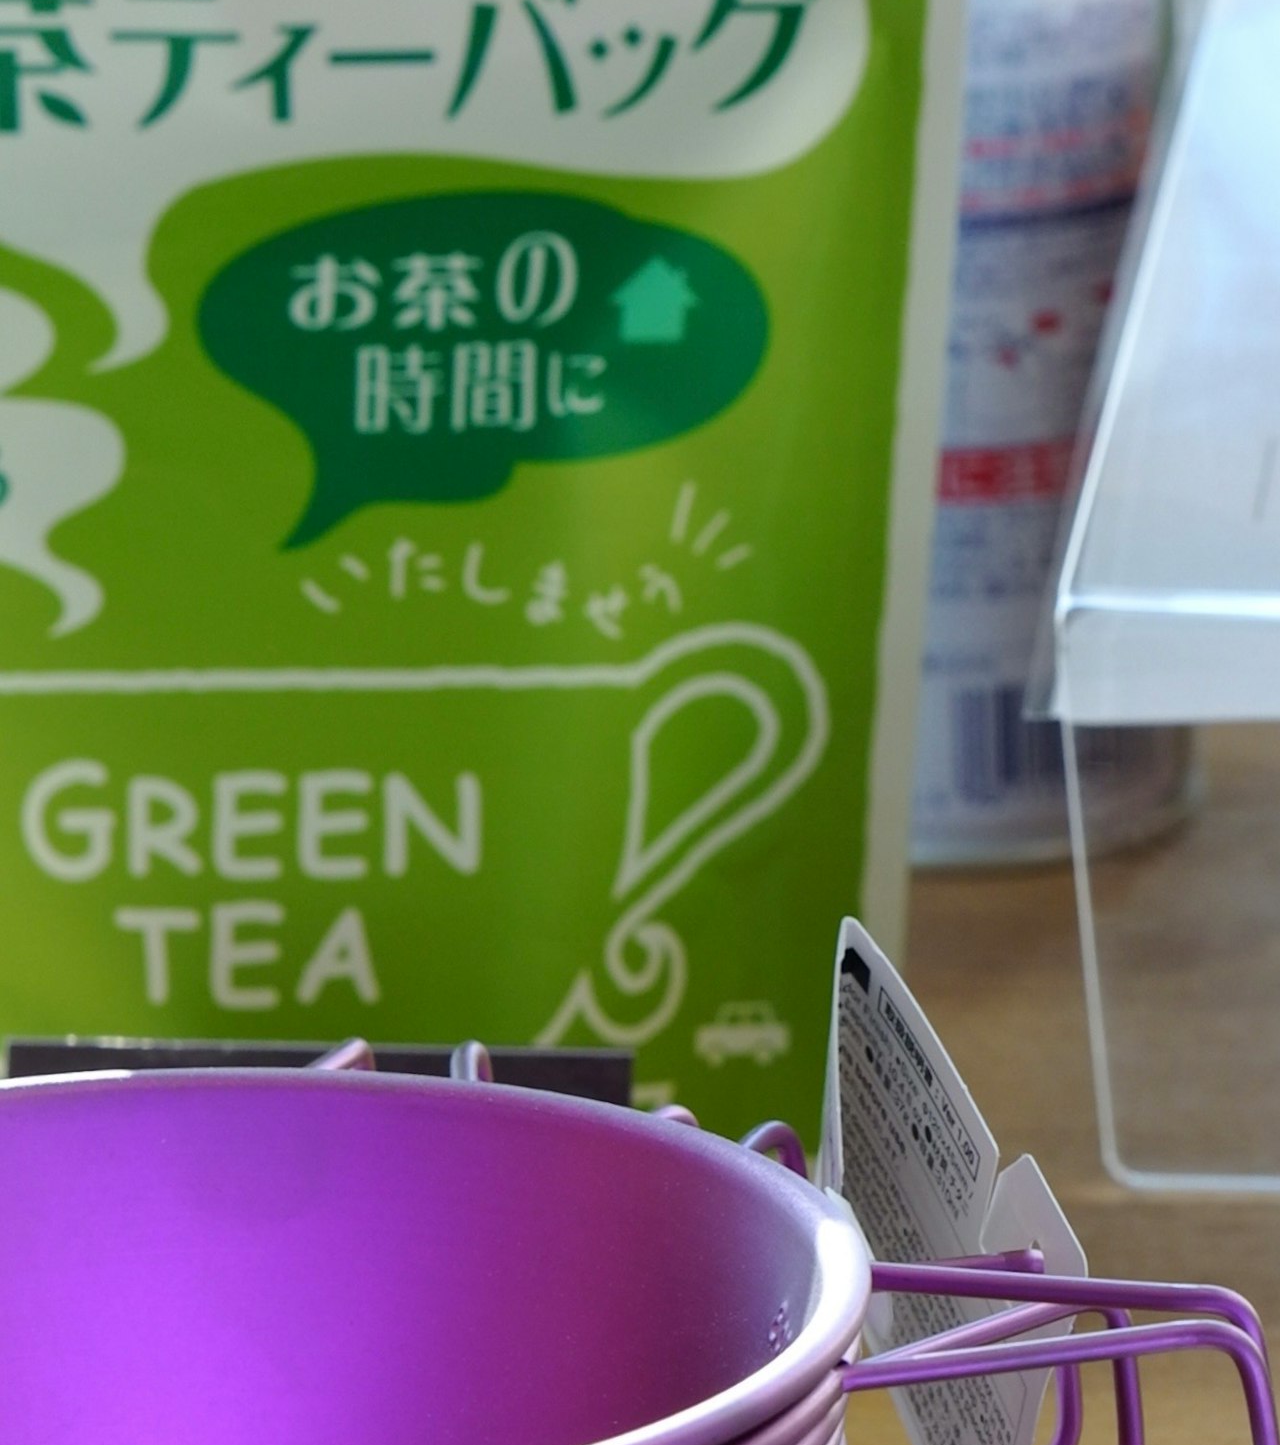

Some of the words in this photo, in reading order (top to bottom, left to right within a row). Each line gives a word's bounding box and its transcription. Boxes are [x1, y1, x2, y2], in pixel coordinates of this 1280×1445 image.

[288, 230, 579, 332] お茶の
[354, 340, 607, 434] 時間に
[19, 759, 482, 883] GREEN
[114, 900, 383, 1011] TEA
